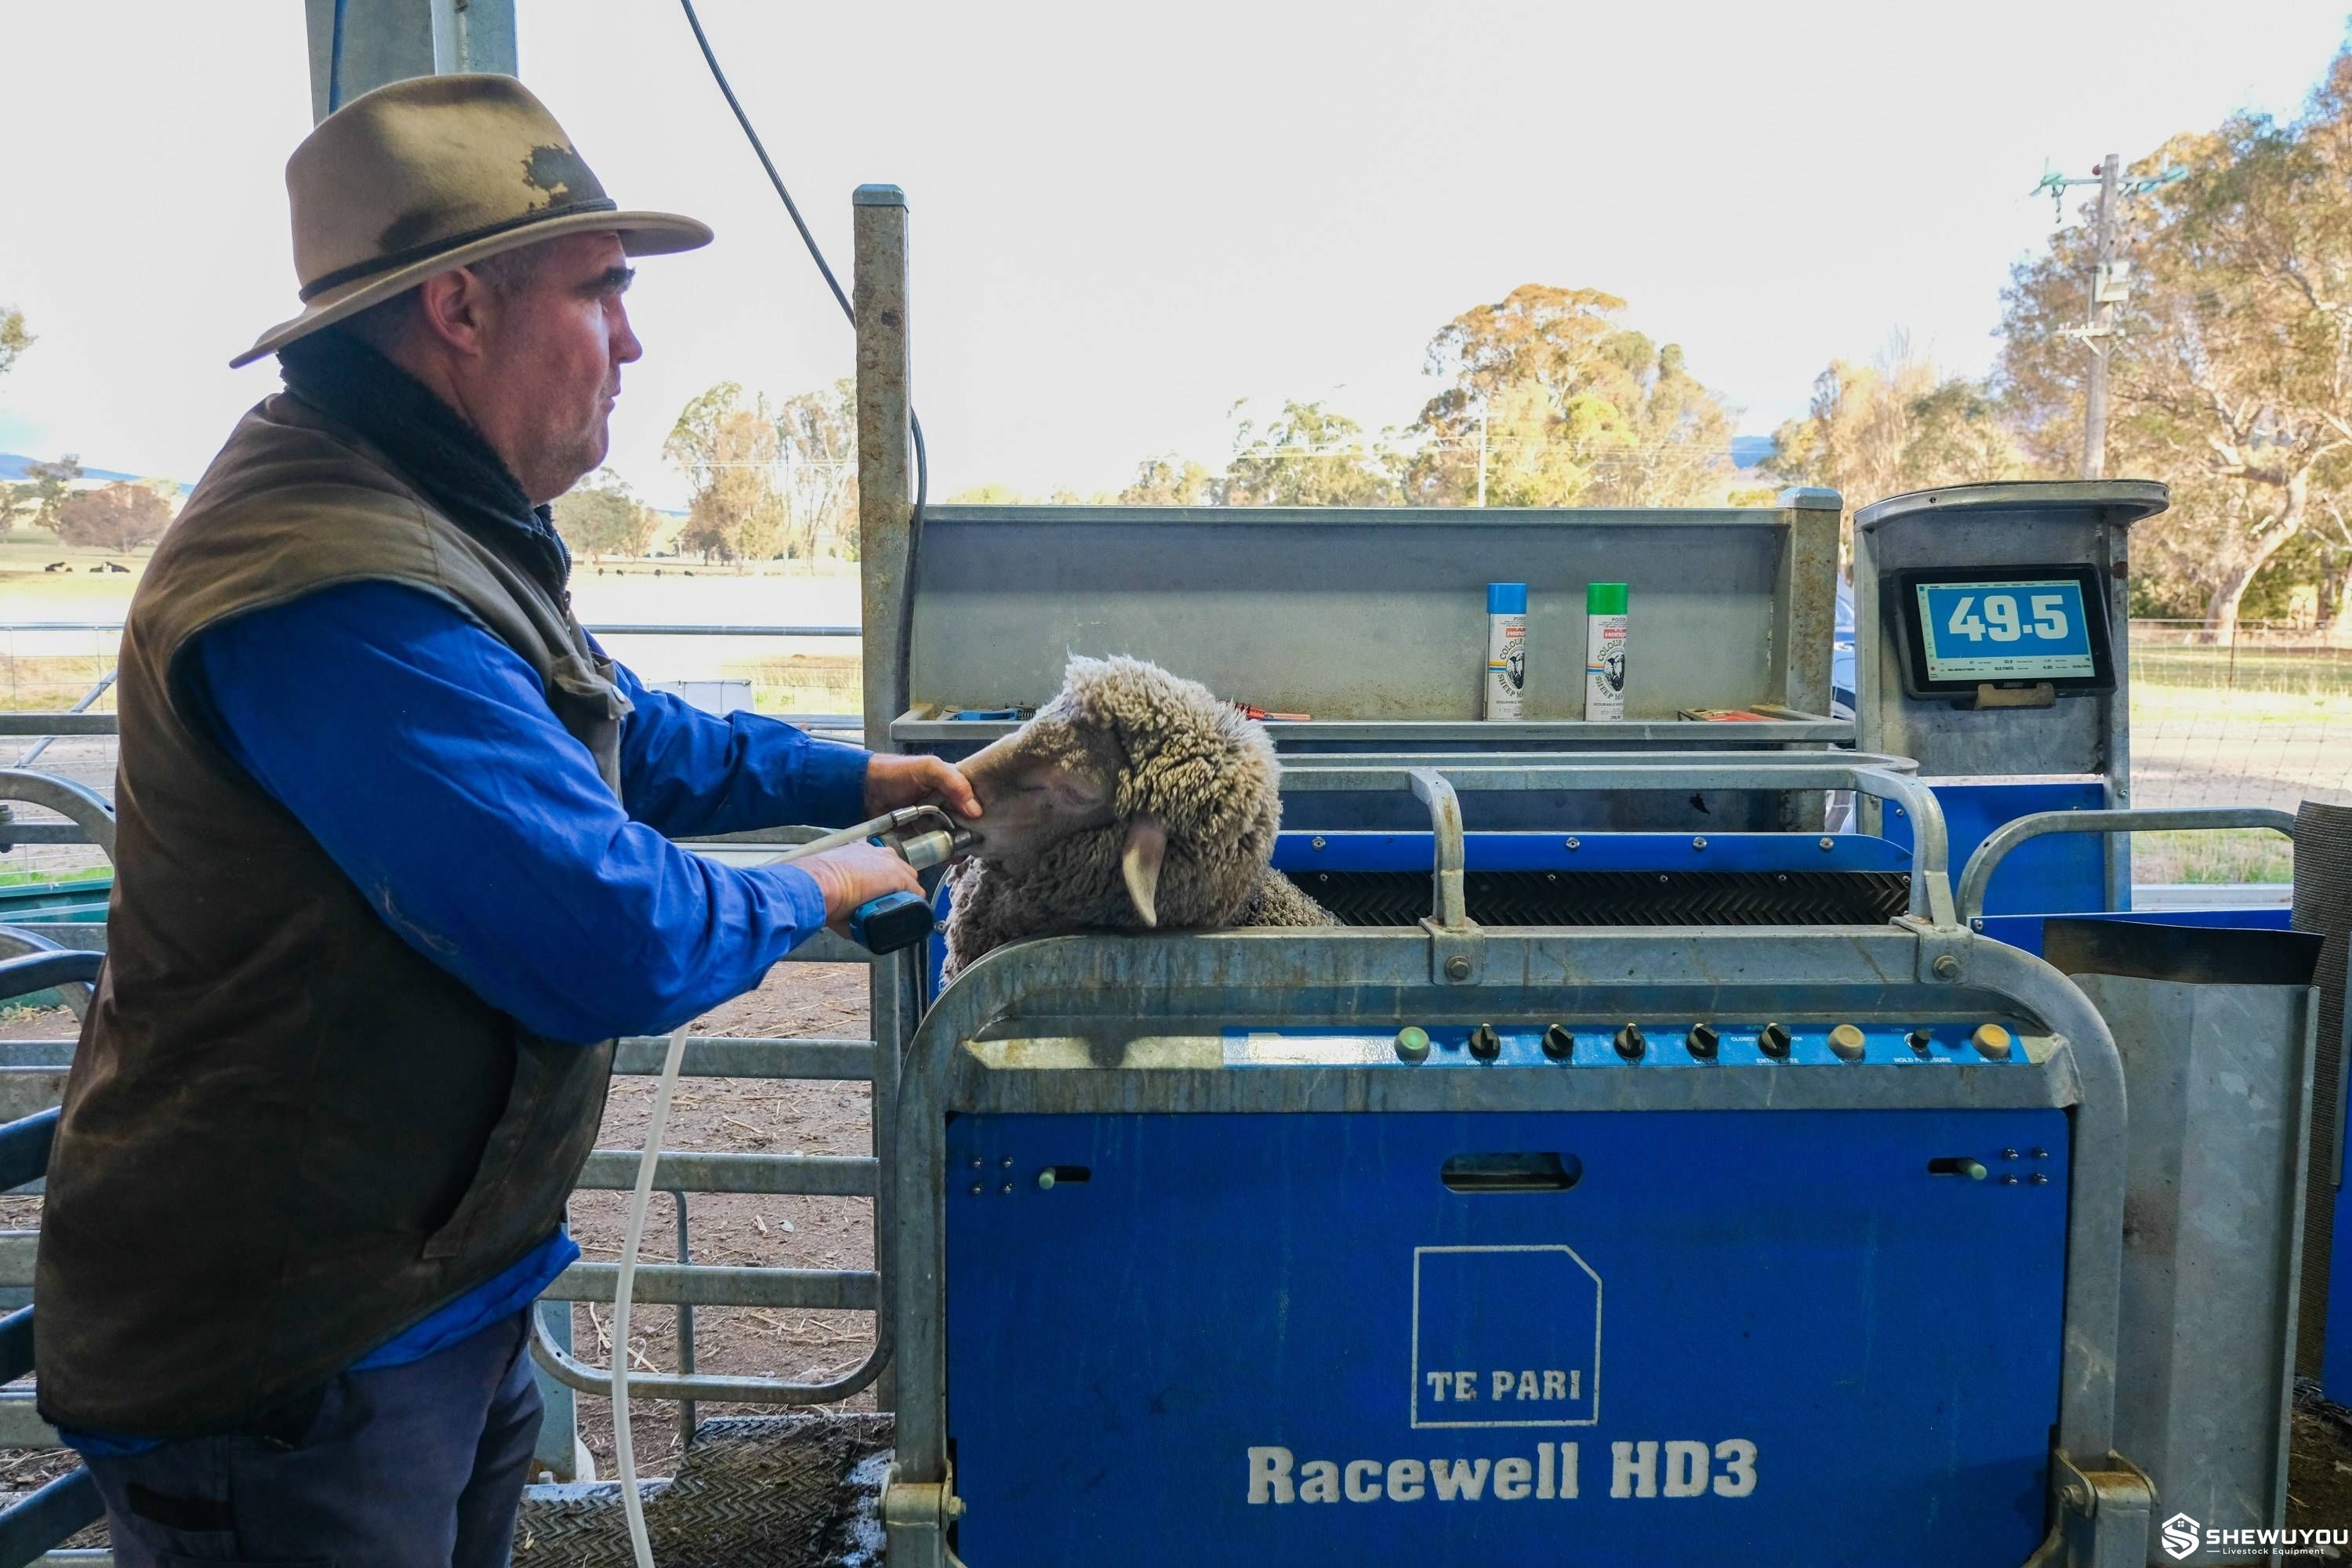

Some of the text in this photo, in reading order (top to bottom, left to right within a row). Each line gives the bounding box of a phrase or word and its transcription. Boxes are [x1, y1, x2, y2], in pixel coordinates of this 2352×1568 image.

[1948, 595, 2068, 641] 49.5
[1499, 638, 1523, 660] COLOUR
[1597, 639, 1622, 661] COLOUR
[1497, 673, 1515, 697] SHEEP
[1595, 676, 1613, 699] SHEEP
[1427, 1370, 1581, 1402] TE PARI
[1247, 1439, 1758, 1504] Racewell HD3
